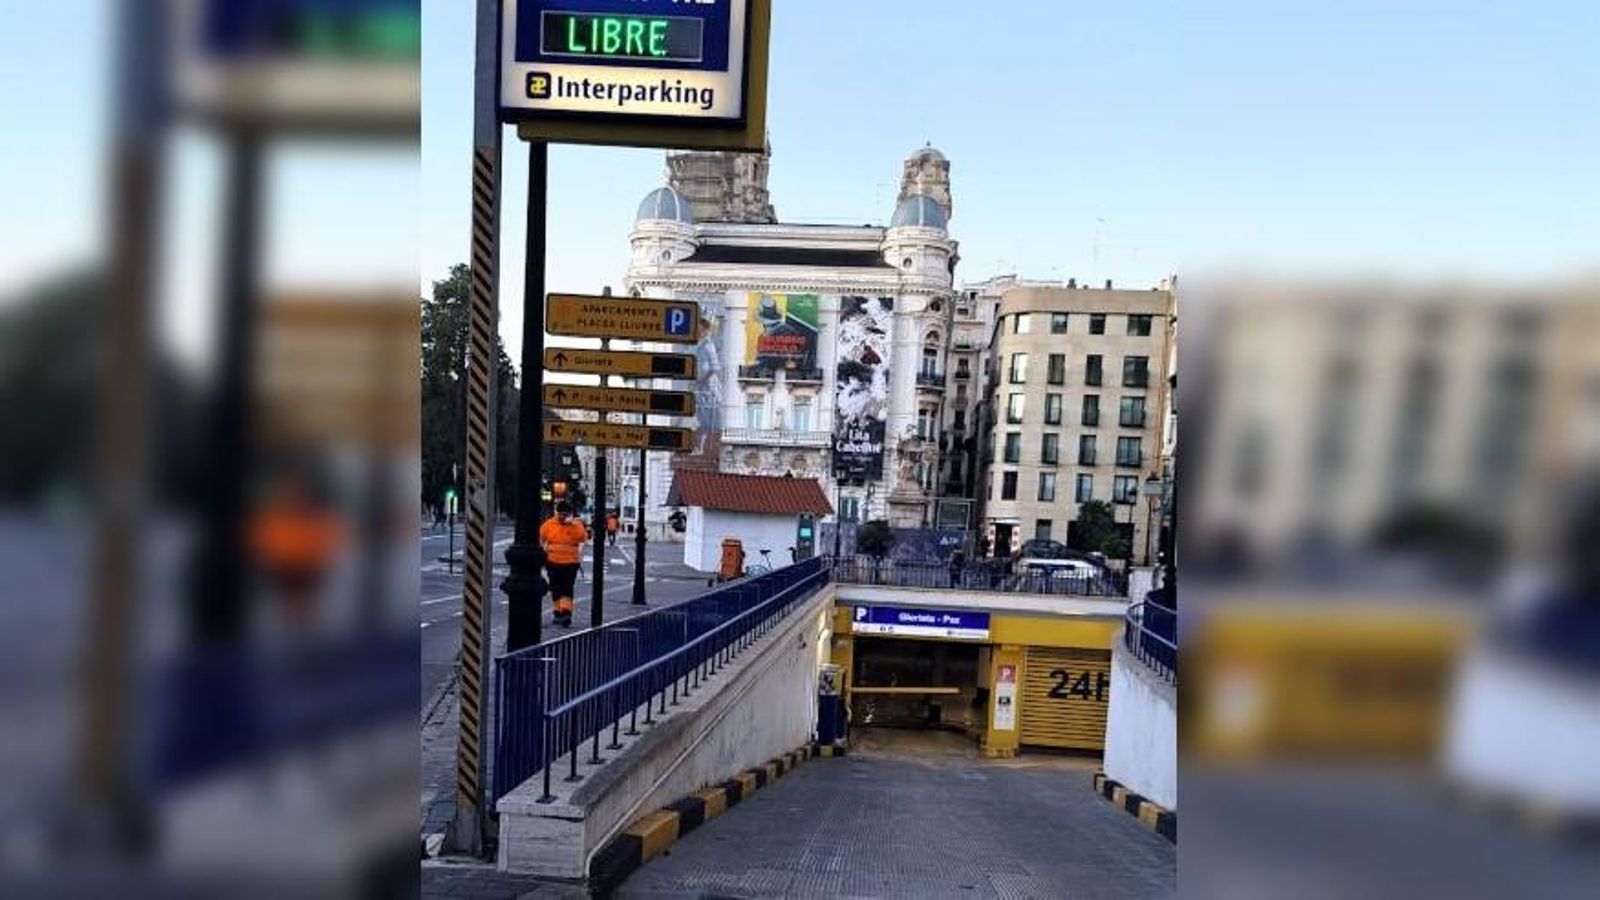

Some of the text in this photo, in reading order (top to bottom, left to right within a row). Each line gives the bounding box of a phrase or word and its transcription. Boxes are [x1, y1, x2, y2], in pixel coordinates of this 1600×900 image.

[568, 16, 668, 55] LIBRE
[557, 75, 715, 110] Interparking
[671, 309, 684, 333] P
[856, 607, 867, 620] P
